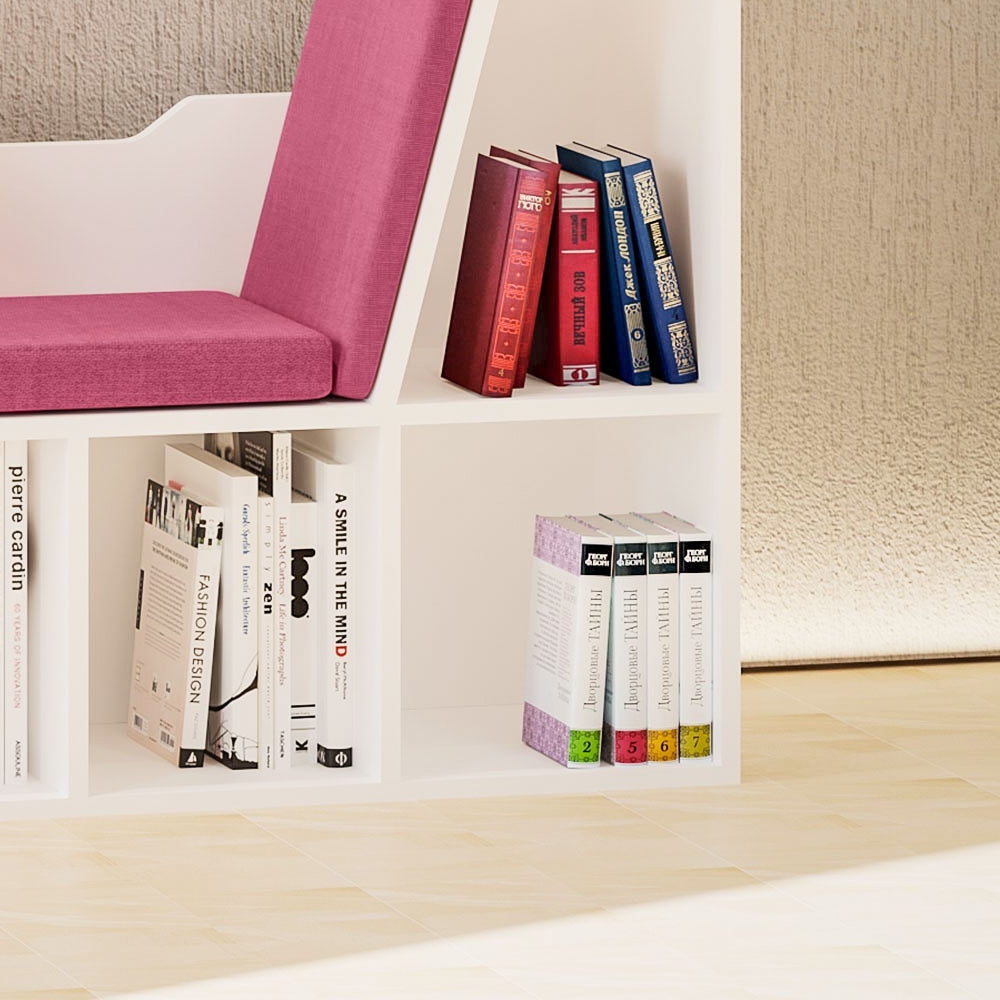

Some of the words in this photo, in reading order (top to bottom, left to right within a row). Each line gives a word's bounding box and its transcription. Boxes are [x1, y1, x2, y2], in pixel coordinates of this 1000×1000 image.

[573, 271, 586, 292] ЗОВ
[571, 296, 586, 346] ВЕЧНЫЙ
[577, 370, 583, 380] 1
[8, 466, 27, 523] pierre
[335, 493, 347, 504] A
[279, 516, 287, 543] Linda
[335, 509, 347, 556] SMILE
[11, 530, 27, 591] cardin
[335, 561, 347, 576] IN
[195, 574, 210, 642] FASHION
[263, 582, 273, 615] zen
[279, 603, 287, 619] Life
[335, 582, 347, 610] THE
[586, 589, 603, 642] ТАЙНЫ
[622, 589, 638, 642] ТАЙНЫ
[656, 587, 670, 641] ТАЙНЫ
[689, 586, 703, 639] ТАЙНЫ
[14, 615, 22, 642] YEARS
[279, 621, 287, 631] in
[335, 616, 347, 657] MIND
[14, 645, 22, 655] OF
[277, 632, 287, 686] Photographs
[14, 657, 22, 709] INNOVATION
[190, 648, 205, 704] DESIGN
[583, 645, 600, 712] Дворцовые
[624, 645, 642, 712] Дворцовые
[658, 644, 673, 711] Дворцовые
[691, 641, 706, 707] Дворцовые
[295, 739, 308, 752] K
[582, 741, 591, 753] 2
[628, 741, 637, 753] 5
[660, 740, 669, 752] 6
[692, 736, 700, 748] 7
